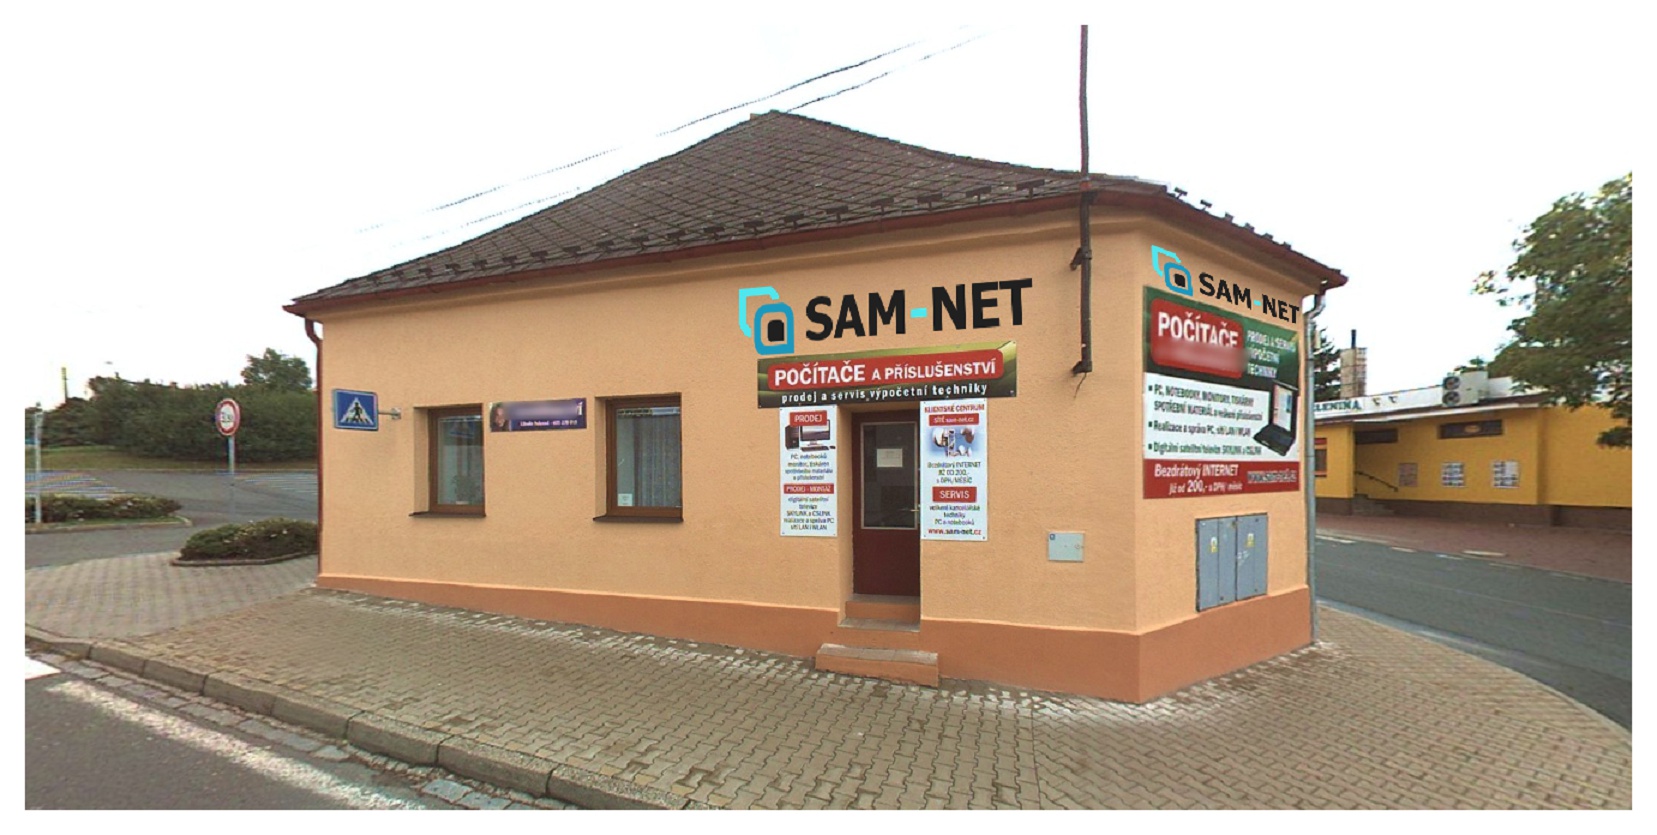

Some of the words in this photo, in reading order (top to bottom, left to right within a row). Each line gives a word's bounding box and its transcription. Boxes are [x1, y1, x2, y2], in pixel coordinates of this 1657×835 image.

[1199, 272, 1299, 324] SAM-NET
[806, 278, 1032, 341] SAM-NET
[775, 360, 865, 386] POČÍTAČE
[872, 369, 881, 380] A
[884, 358, 996, 380] PŘÍSLUŠENSTVÍ
[782, 391, 816, 404] prodej
[821, 393, 827, 401] a
[831, 390, 866, 400] servis
[870, 384, 927, 400] výpočetní
[932, 382, 987, 395] techniky
[956, 404, 984, 412] CENTRUM
[794, 414, 822, 422] PRODEJ
[1154, 463, 1201, 480] Bezdrátový
[1202, 464, 1239, 476] INTERNET
[940, 490, 970, 498] SERVIS
